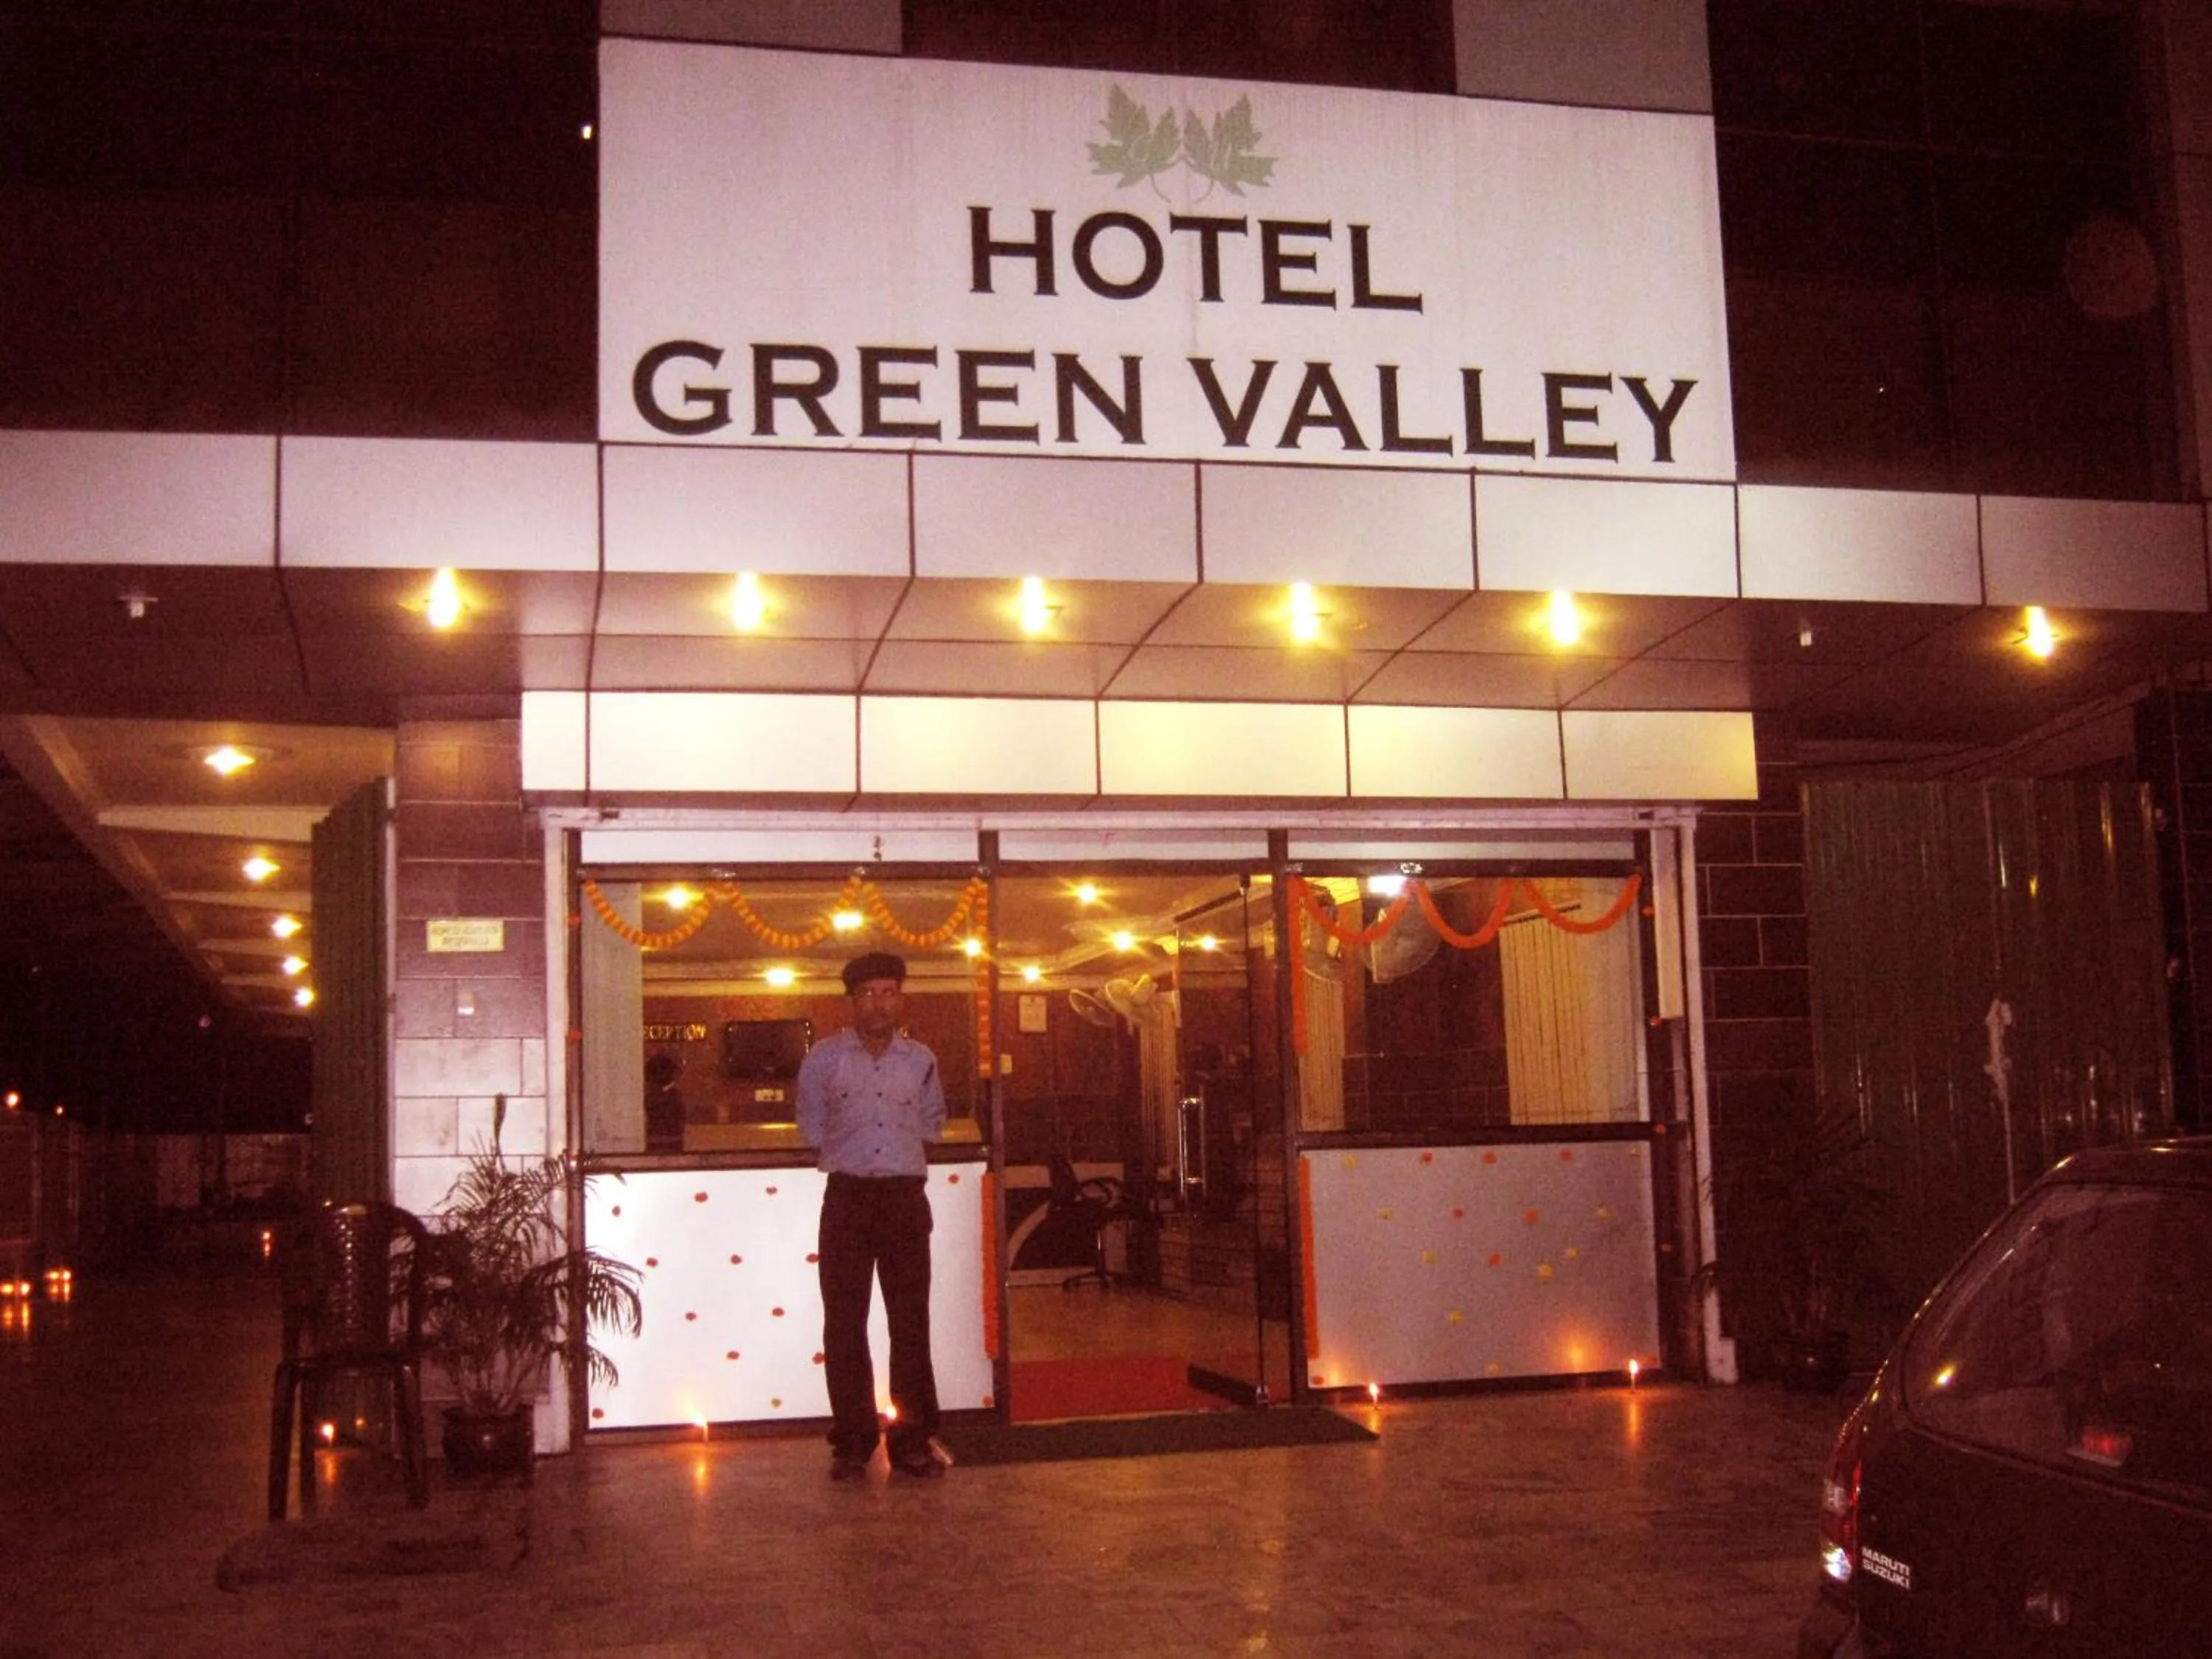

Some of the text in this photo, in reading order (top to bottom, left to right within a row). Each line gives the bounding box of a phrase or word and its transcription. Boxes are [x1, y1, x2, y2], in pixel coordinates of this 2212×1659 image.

[967, 206, 1423, 314] HOTEL
[633, 340, 1698, 463] GREEN VALLEY
[643, 1023, 706, 1040] ECEPTION
[1862, 1546, 1910, 1576] MARUTI
[1863, 1558, 1910, 1590] SUZUKI
